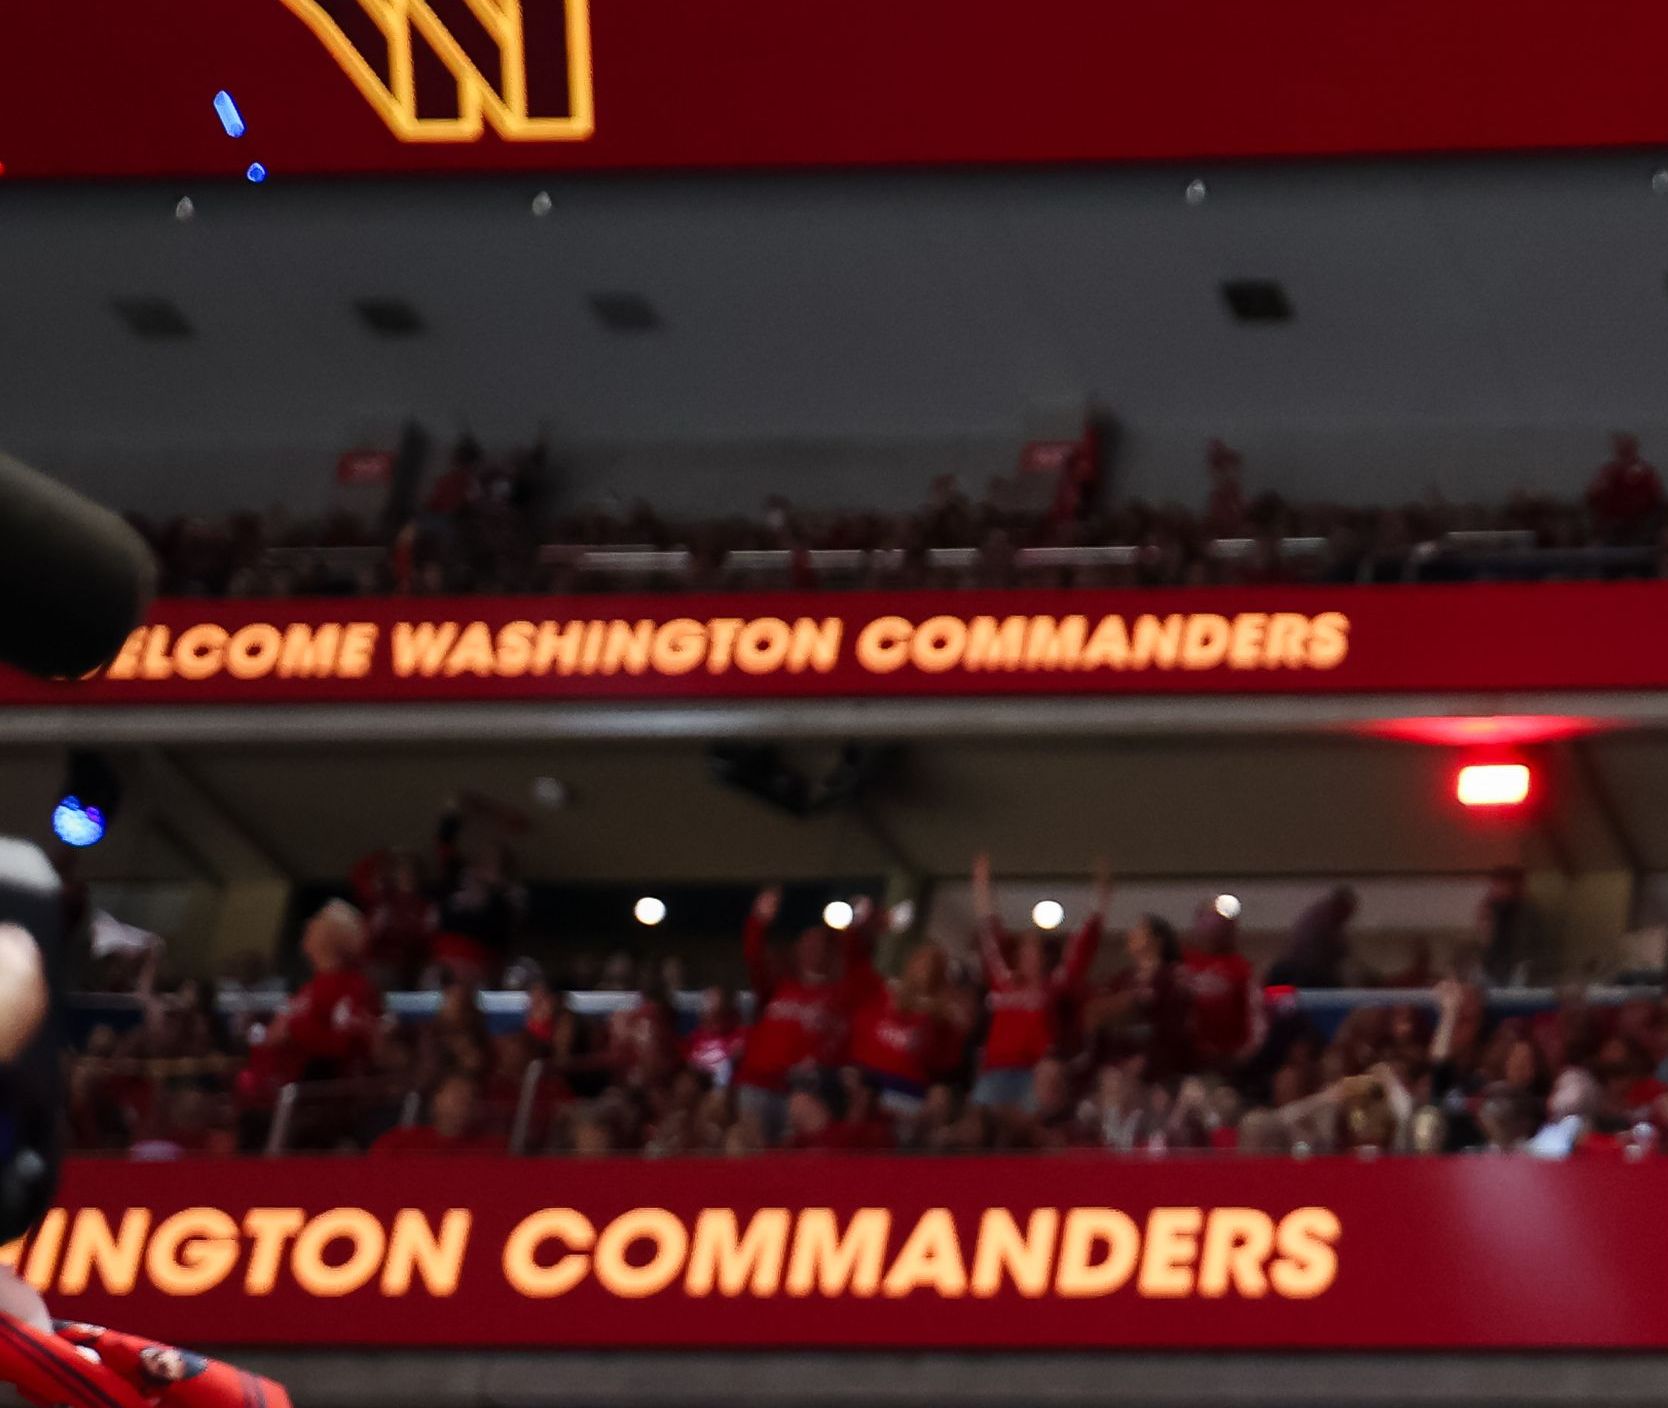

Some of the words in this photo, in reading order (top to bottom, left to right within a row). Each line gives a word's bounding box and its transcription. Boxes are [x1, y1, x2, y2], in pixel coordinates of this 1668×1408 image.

[80, 621, 380, 680] ELCOME
[391, 616, 844, 678] WASHINGTON
[855, 611, 1350, 674] COMMANDERS
[503, 1206, 1342, 1299] COMMANDERS
